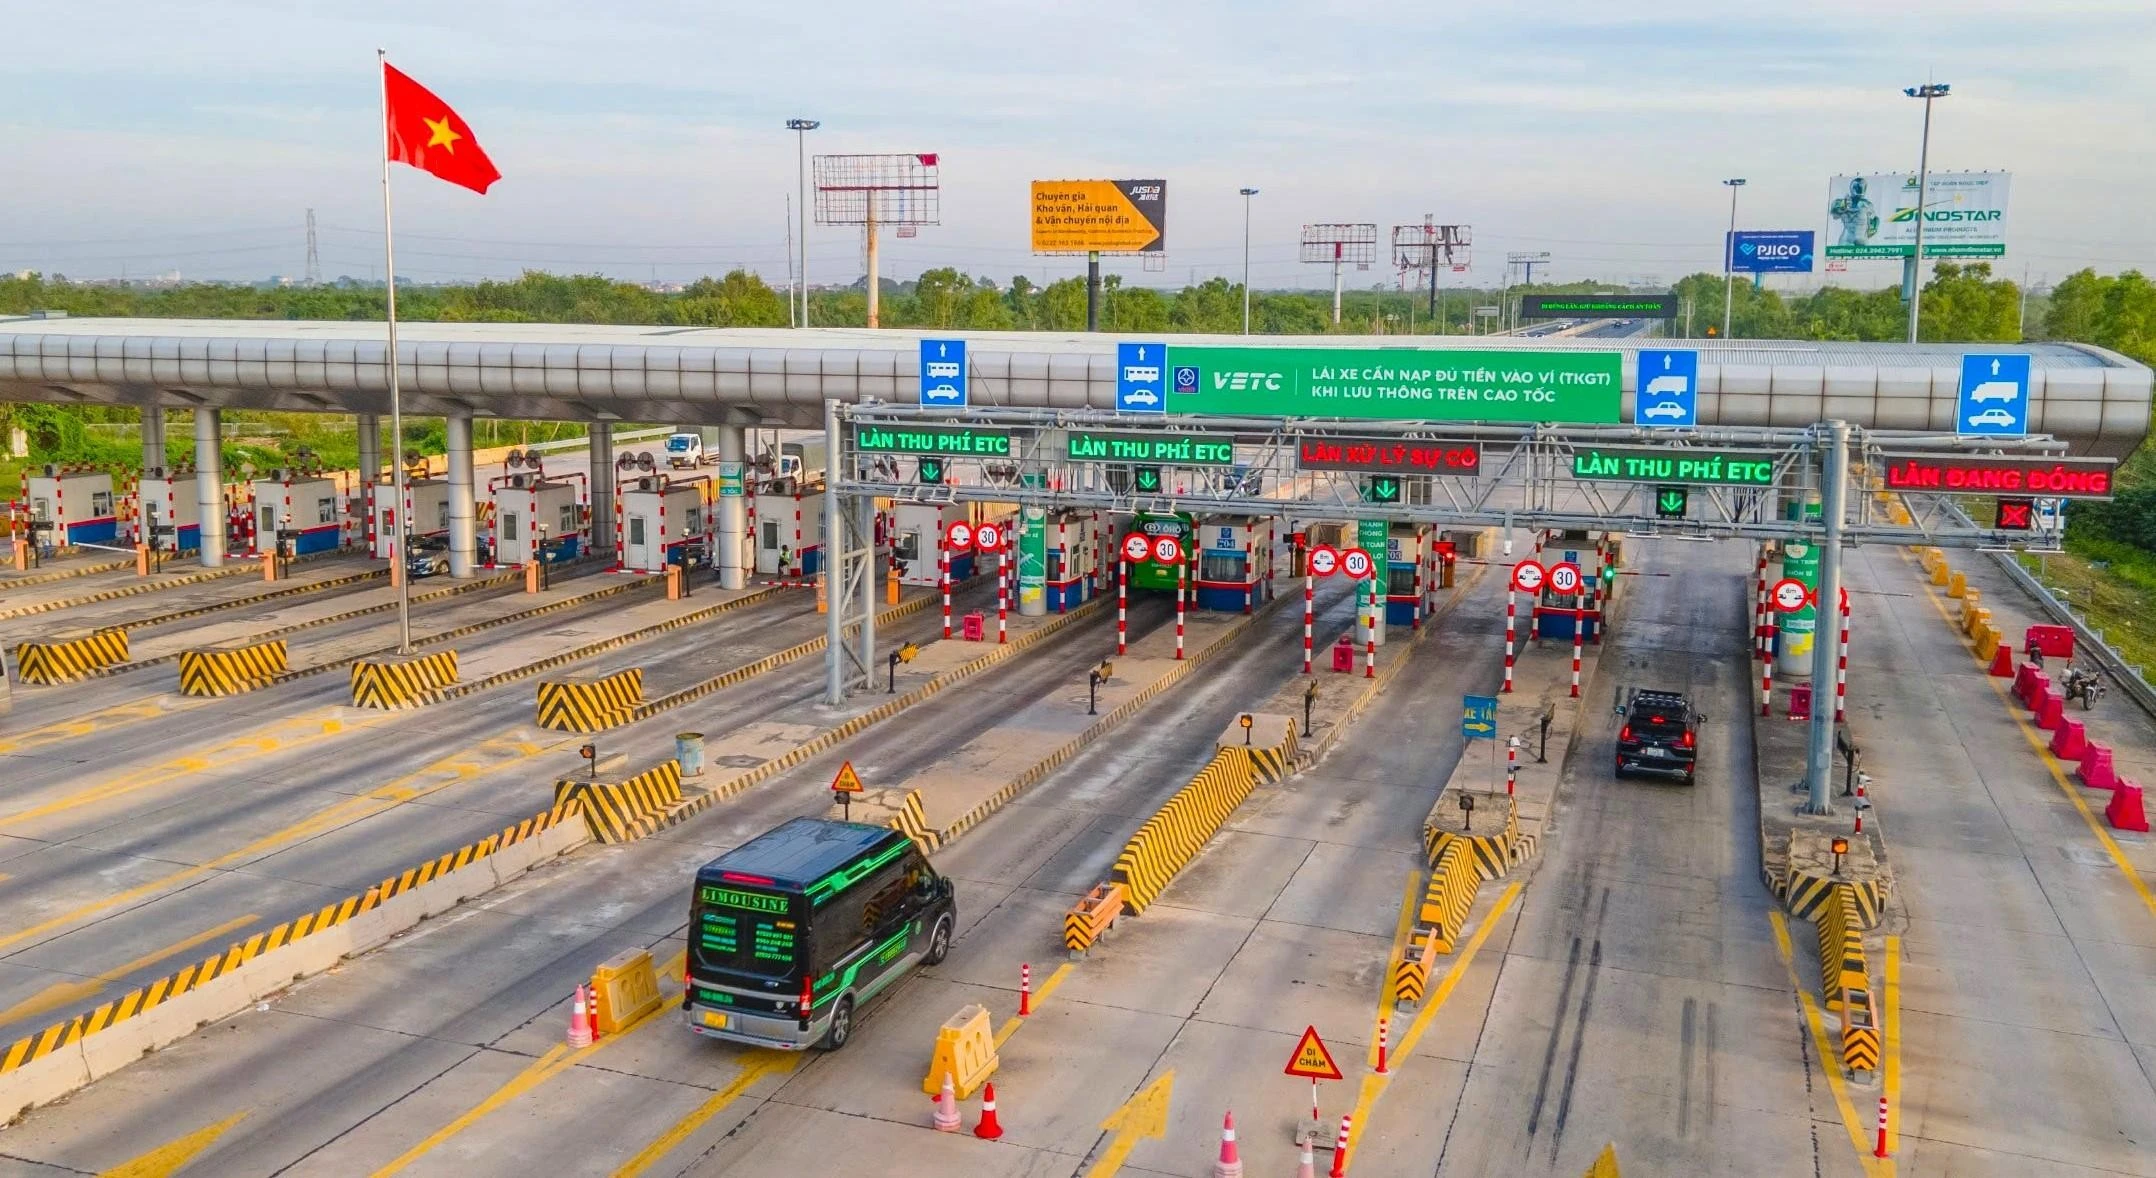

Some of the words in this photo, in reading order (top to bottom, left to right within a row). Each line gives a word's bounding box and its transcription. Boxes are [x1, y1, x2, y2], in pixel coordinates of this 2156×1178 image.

[1036, 192, 1070, 202] Chuyên
[1072, 193, 1086, 202] gia
[1036, 204, 1053, 212] Kho
[1096, 205, 1117, 214] quan
[1757, 245, 1800, 256] PJICO
[1213, 372, 1283, 390] VETC
[1312, 365, 1335, 380] LÁI
[1340, 368, 1358, 380] XE
[1400, 370, 1431, 385] NẠP
[1435, 367, 1457, 382] ĐỦ
[1501, 369, 1534, 384] VÀO
[1538, 371, 1555, 384] VÍ
[1559, 372, 1611, 386] (TKGT)
[1312, 386, 1338, 397] KHI
[1343, 386, 1372, 399] LƯU
[1377, 385, 1433, 400] THÔNG
[1438, 386, 1478, 401] TRÊN
[1483, 389, 1518, 401] CAO
[1523, 386, 1556, 402] TỐC
[860, 428, 893, 448] LÀN
[898, 434, 933, 450] THU
[938, 431, 971, 451] PHÍ
[975, 437, 1008, 453] ETC
[1071, 435, 1106, 456] LÀN
[1111, 442, 1149, 458] THU
[1155, 439, 1190, 459] PHÍ
[1195, 444, 1231, 461] ETC
[1576, 452, 1619, 474] LÀN
[1626, 458, 1672, 477] THU
[1679, 456, 1721, 478] PHÍ
[1727, 462, 1771, 482] ETC
[1890, 460, 1940, 487] LÀN
[1946, 467, 2021, 489] ĐANG
[2027, 464, 2108, 492] ĐÓNG
[981, 531, 994, 544] 30
[1160, 543, 1174, 556] 30
[1350, 557, 1364, 569] 30
[1556, 572, 1573, 586] 30
[702, 888, 788, 912] LIMOUSINE
